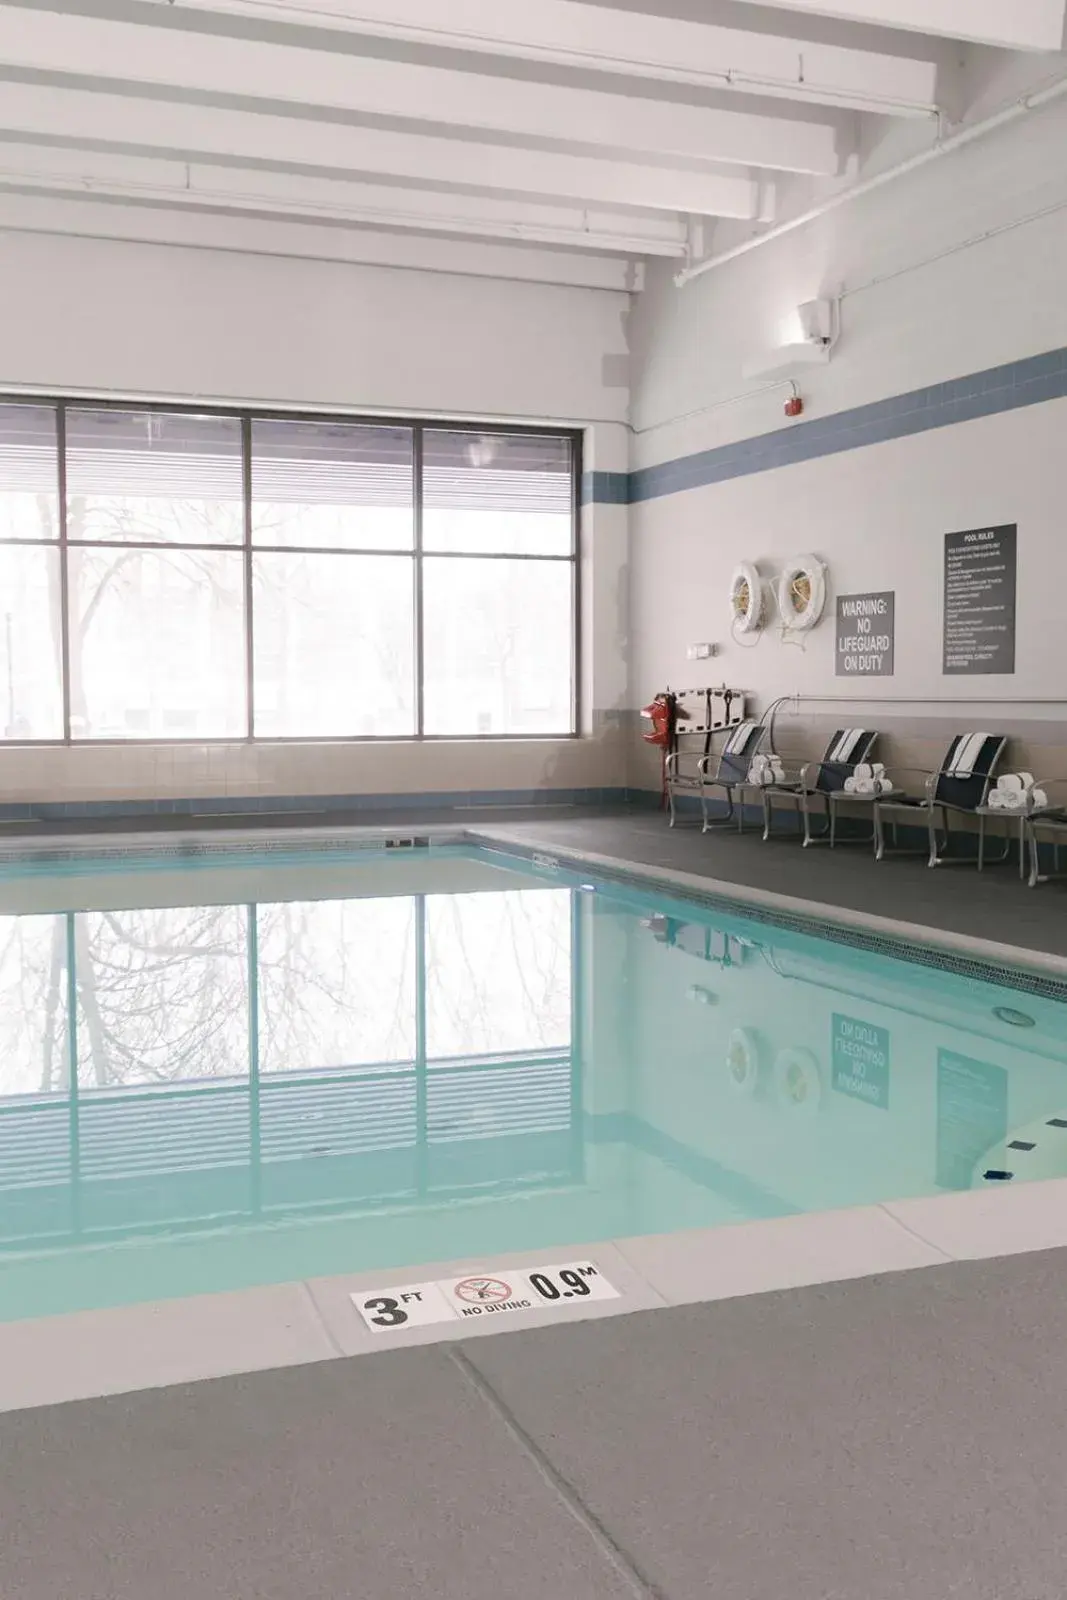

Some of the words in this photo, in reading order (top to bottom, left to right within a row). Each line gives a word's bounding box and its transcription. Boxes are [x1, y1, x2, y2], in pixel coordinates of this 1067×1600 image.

[964, 534, 978, 542] POOL
[842, 600, 888, 616] WARNING:
[857, 618, 870, 633] NO
[839, 635, 890, 652] LIFEGUARD
[844, 655, 858, 671] ON
[858, 654, 883, 671] DUTY
[528, 1269, 591, 1300] 0.9
[580, 1266, 598, 1277] M
[364, 1297, 408, 1326] 3
[400, 1291, 423, 1304] FT
[461, 1306, 483, 1317] NO
[484, 1299, 532, 1313] DIVING
